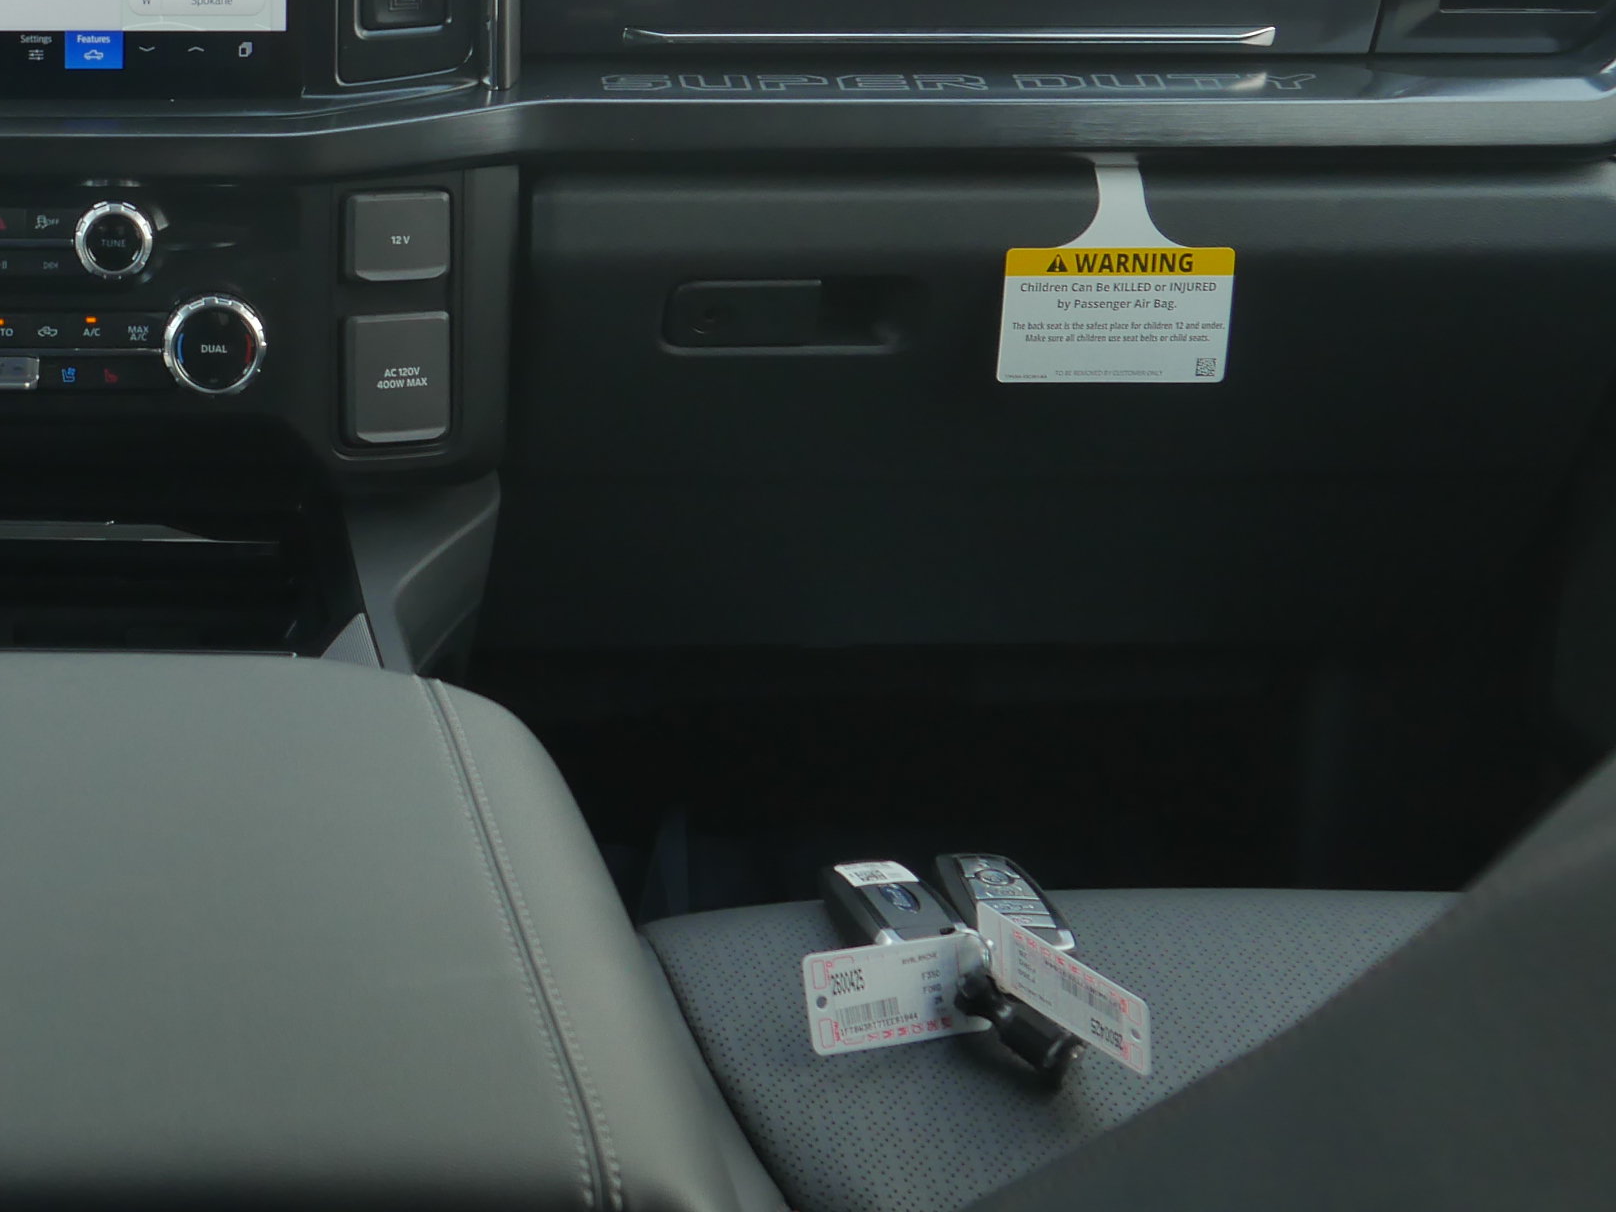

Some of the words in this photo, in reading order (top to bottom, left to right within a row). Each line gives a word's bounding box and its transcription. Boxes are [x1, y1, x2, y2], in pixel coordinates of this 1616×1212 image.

[20, 34, 52, 45] Settings
[76, 34, 110, 44] Features
[602, 73, 990, 90] SUPER
[101, 239, 126, 248] TUNE
[391, 236, 402, 245] 12
[403, 236, 411, 245] V
[1074, 253, 1194, 273] WARNING
[1020, 282, 1068, 293] Children
[1071, 282, 1093, 293] Can
[1096, 282, 1110, 293] Be
[1113, 282, 1152, 293] KILLED
[1154, 284, 1166, 293] or
[1169, 282, 1217, 294] INJURED
[1057, 298, 1071, 311] by
[1074, 299, 1132, 311] Passenger
[1134, 298, 1151, 309] Air
[1154, 298, 1177, 311] Bag.
[128, 326, 149, 334] MAX
[1012, 322, 1026, 330] The
[1027, 322, 1044, 330] back
[1046, 322, 1062, 330] seat
[1072, 322, 1084, 330] the
[1086, 322, 1108, 330] safest
[1109, 322, 1129, 332] place
[1130, 322, 1142, 330] for
[1143, 322, 1173, 330] children
[1186, 322, 1200, 330] and
[83, 328, 100, 337] A/C
[130, 333, 147, 341] A/C
[1025, 334, 1046, 342] Make
[1047, 334, 1064, 342] sure
[1065, 334, 1075, 342] all
[1076, 334, 1106, 342] children
[1108, 334, 1121, 342] use
[1123, 334, 1138, 342] seat
[1140, 334, 1158, 342] belts
[1169, 334, 1187, 342] child
[200, 344, 227, 354] DUAL
[385, 368, 398, 378] AC
[399, 367, 420, 377] 120V
[377, 379, 405, 389] 400W
[406, 377, 428, 387] MAX
